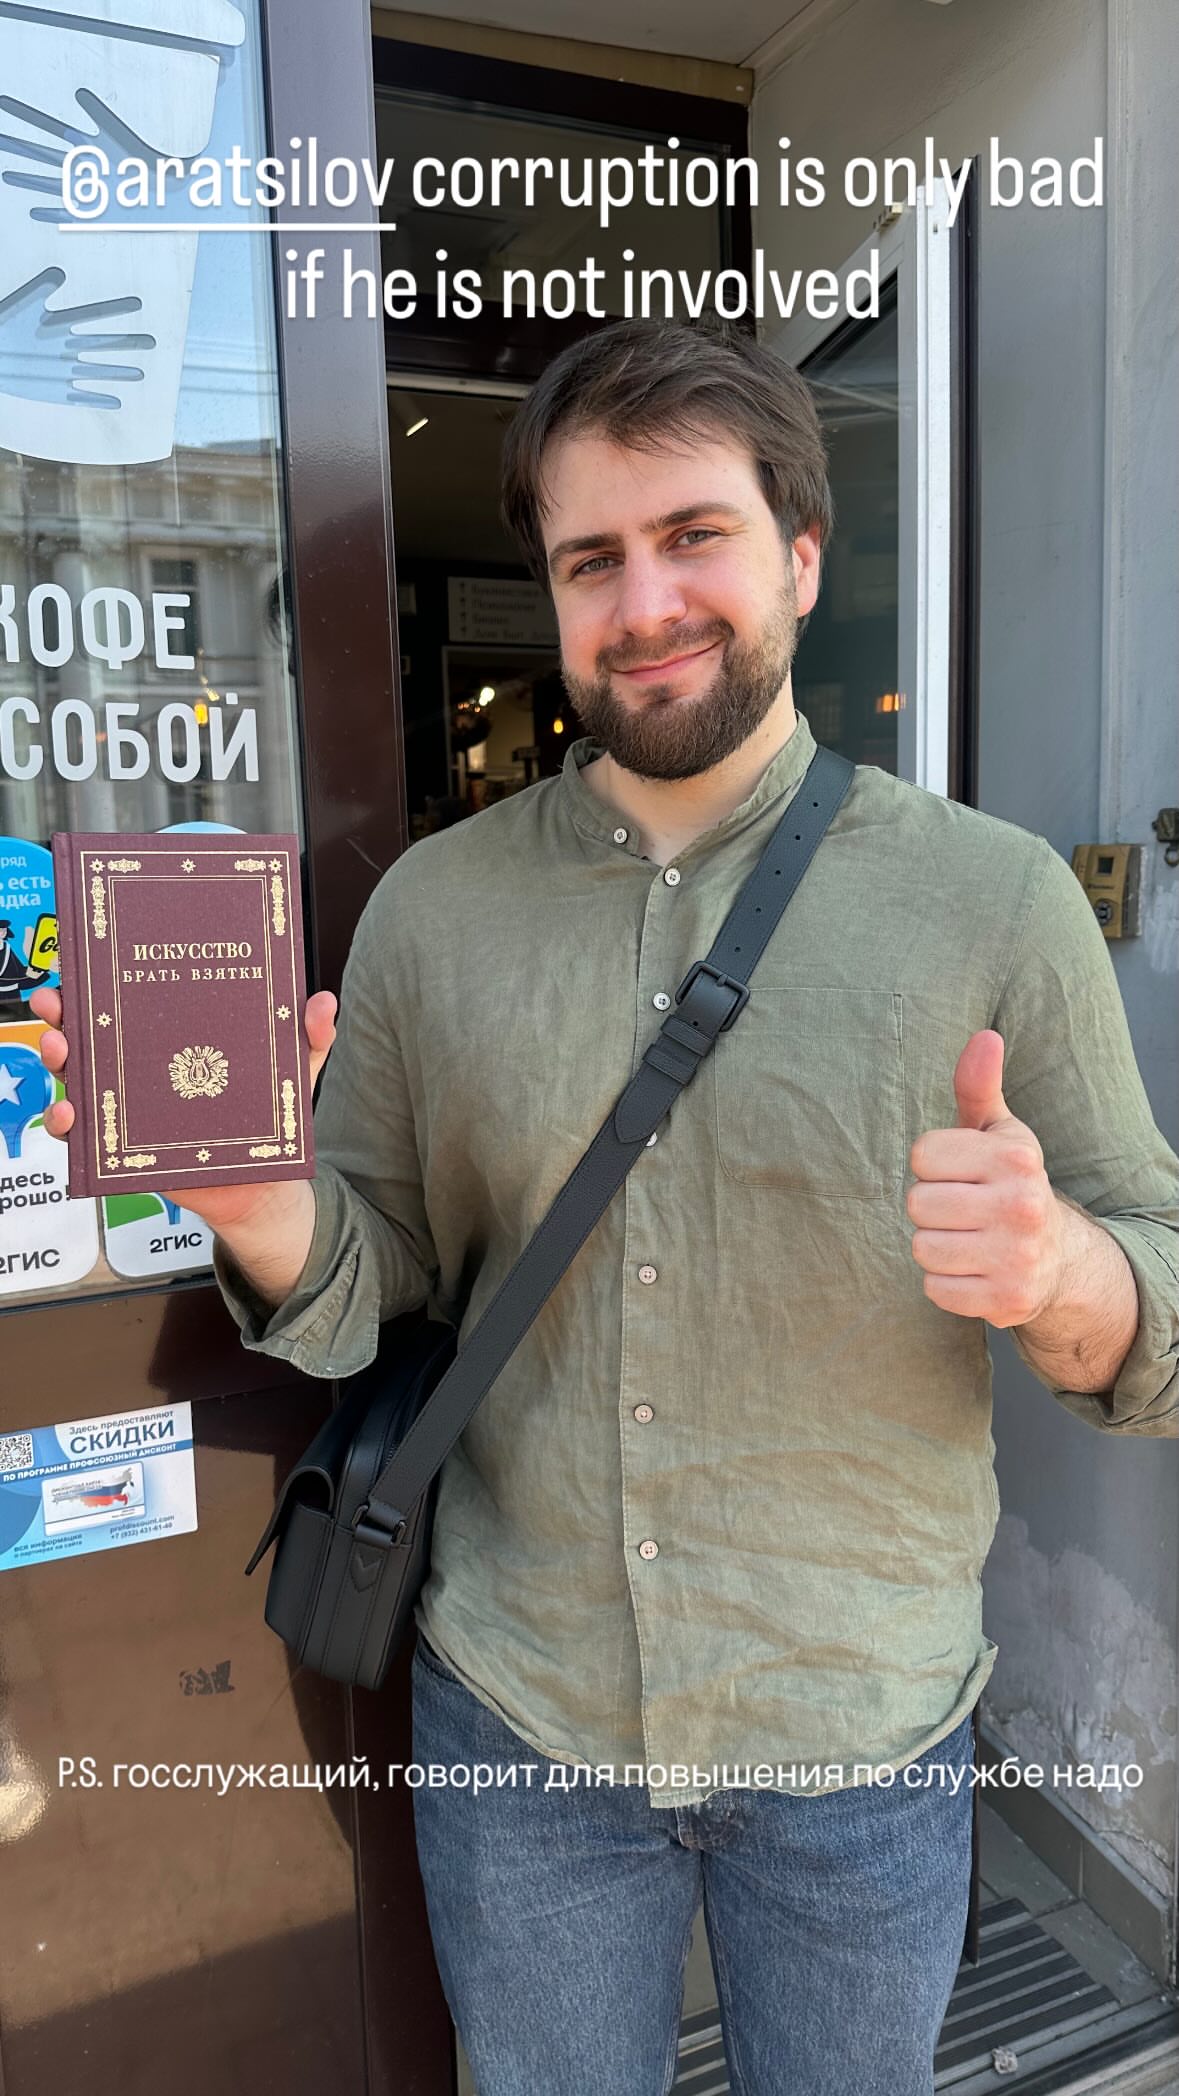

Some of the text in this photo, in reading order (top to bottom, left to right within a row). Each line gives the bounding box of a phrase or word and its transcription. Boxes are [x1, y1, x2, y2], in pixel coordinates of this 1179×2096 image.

[0, 692, 259, 783] СОБОЙ
[7, 876, 52, 889] есть
[132, 942, 252, 961] ИСКУССТВО
[122, 966, 264, 983] БРАТЬ ВЗЯТКИ
[149, 1232, 203, 1254] 2ГИС
[69, 1410, 174, 1436] Здесь предоставляют
[70, 1419, 175, 1454] СКИДКИ
[3, 1443, 177, 1482] ПО ПРОГРАММЕ ПРОФСОЮЗНЫЙ ДИСКОНТ
